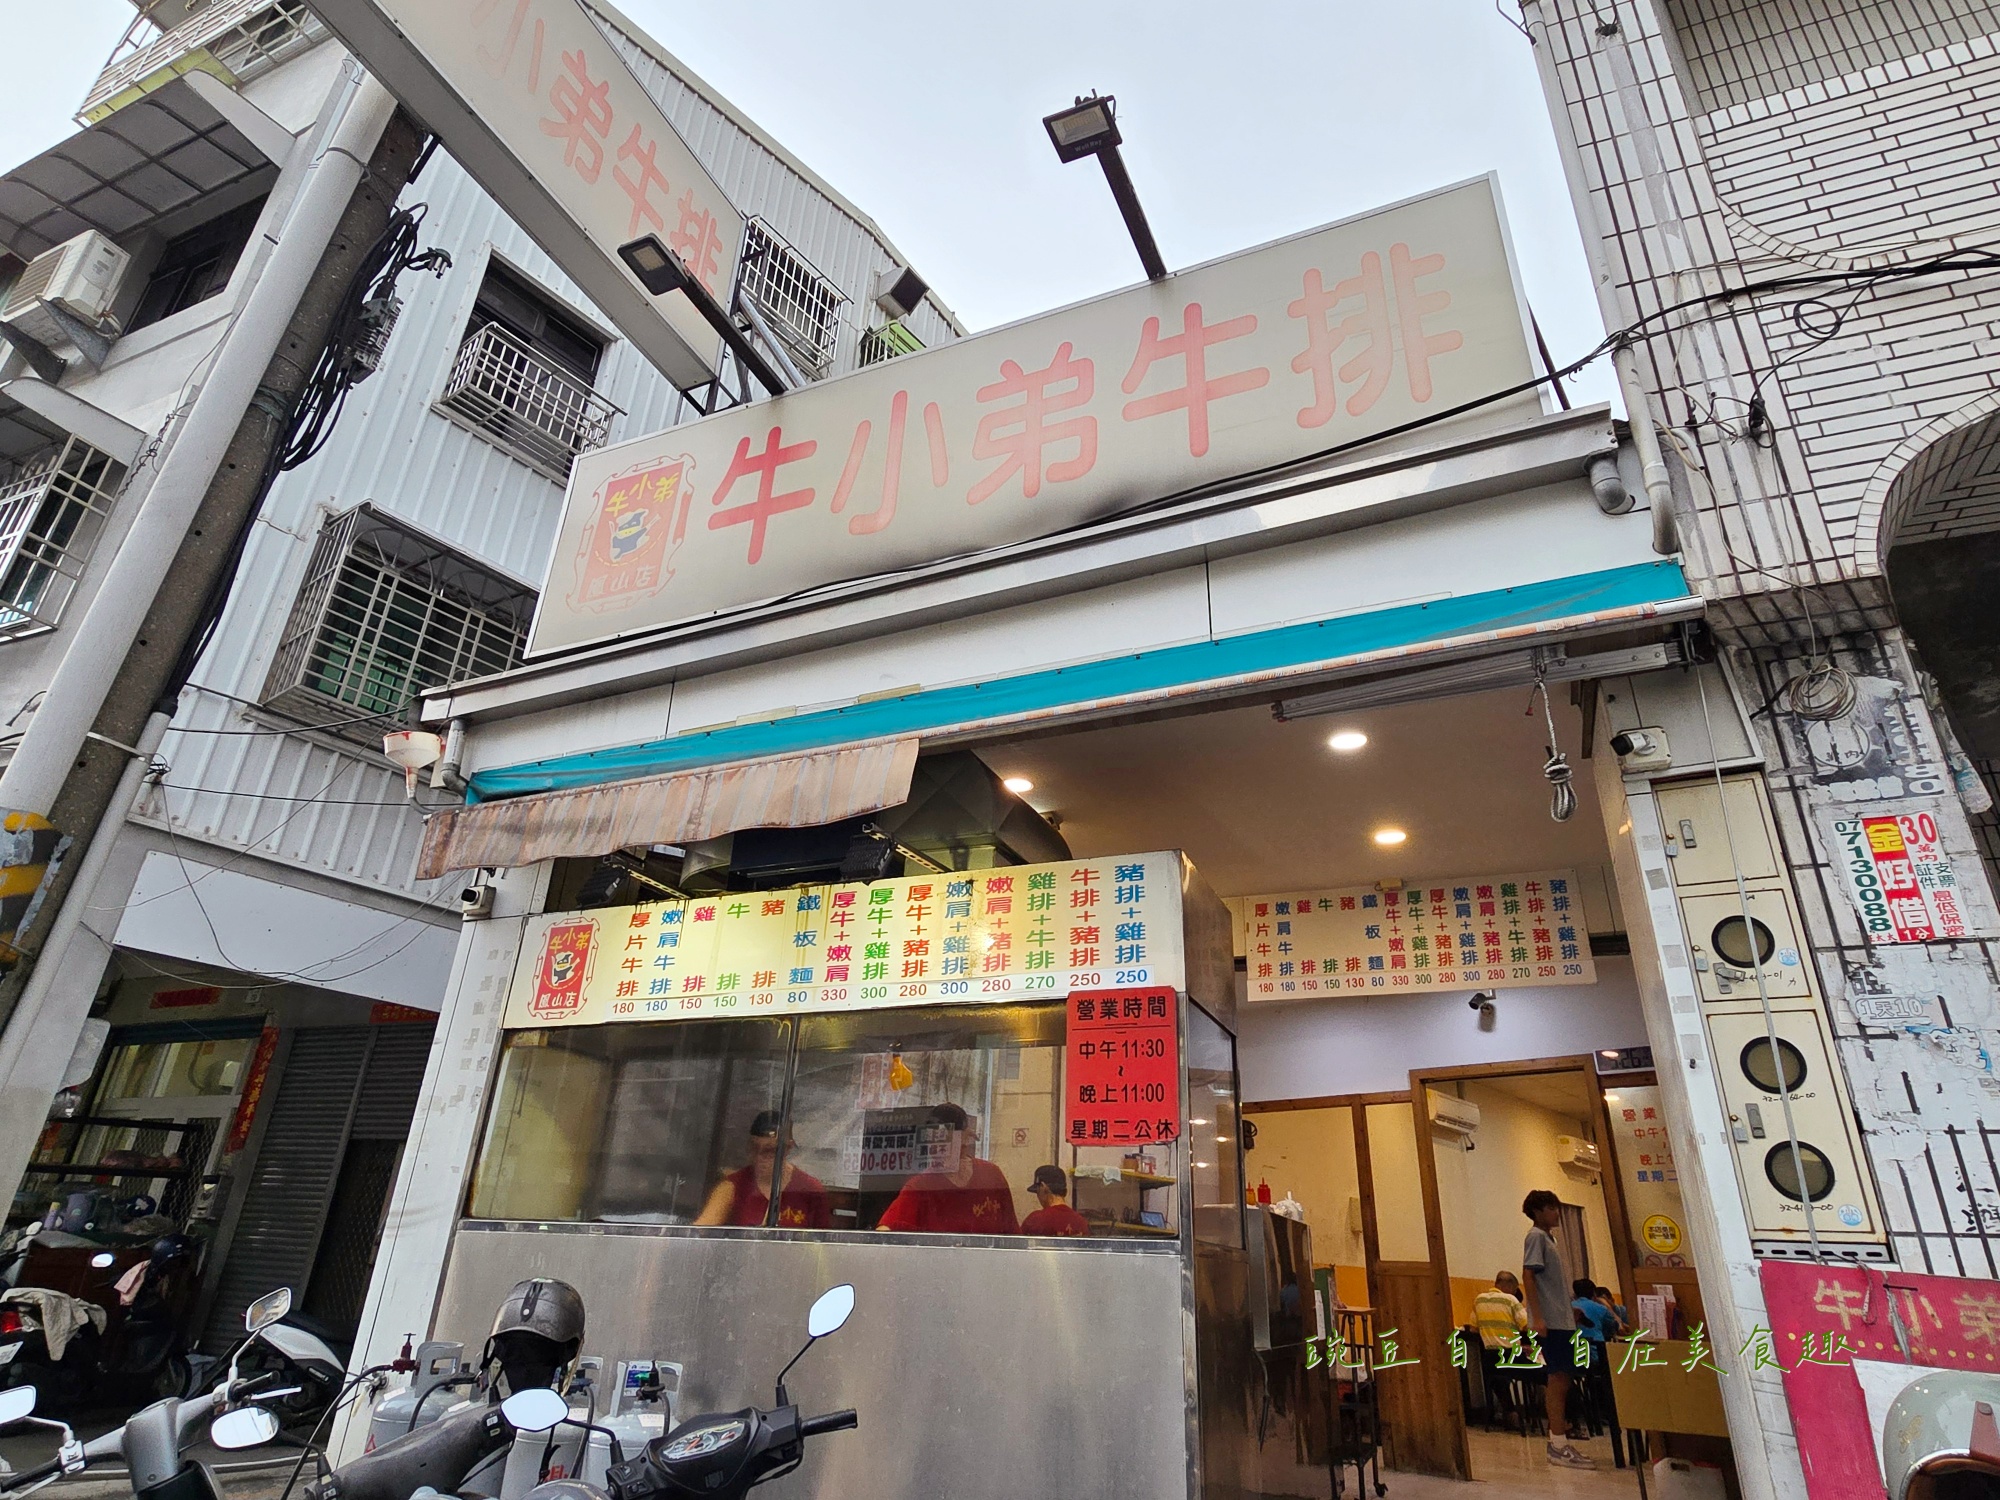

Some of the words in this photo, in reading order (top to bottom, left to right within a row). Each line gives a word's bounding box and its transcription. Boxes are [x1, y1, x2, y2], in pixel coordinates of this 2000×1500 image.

[707, 244, 1464, 566] 牛小弟牛排
[604, 471, 680, 518] 牛小弟
[1900, 813, 1938, 845] 30
[1839, 831, 1893, 932] 7130088
[1866, 822, 1930, 929] 金好借
[1934, 862, 1957, 888] 支票
[549, 927, 591, 954] 牛小弟
[612, 1002, 635, 1014] 180
[645, 999, 668, 1012] 180
[679, 997, 702, 1010] 150
[713, 995, 737, 1008] 150
[749, 993, 773, 1006] 130
[787, 990, 807, 1003] 80
[820, 988, 847, 1001] 330
[860, 986, 887, 1000] 300
[899, 983, 928, 997] 280
[940, 981, 969, 995] 300
[982, 978, 1011, 992] 280
[1025, 976, 1055, 990] 270
[1070, 972, 1101, 987] 250
[1116, 969, 1148, 984] 250
[1258, 983, 1273, 993] 180
[1280, 981, 1295, 992] 180
[1302, 980, 1318, 991] 150
[1324, 979, 1340, 989] 150
[1345, 977, 1365, 988] 130
[1371, 976, 1384, 987] 80
[1392, 975, 1409, 986] 330
[1415, 973, 1432, 984] 300
[1439, 972, 1456, 983] 280
[1463, 970, 1480, 981] 300
[1487, 969, 1505, 980] 280
[1513, 967, 1530, 978] 270
[1538, 966, 1556, 977] 250
[1563, 964, 1582, 975] 250
[1077, 996, 1166, 1020] 營業時間
[1071, 1118, 1174, 1139] 星期二公休
